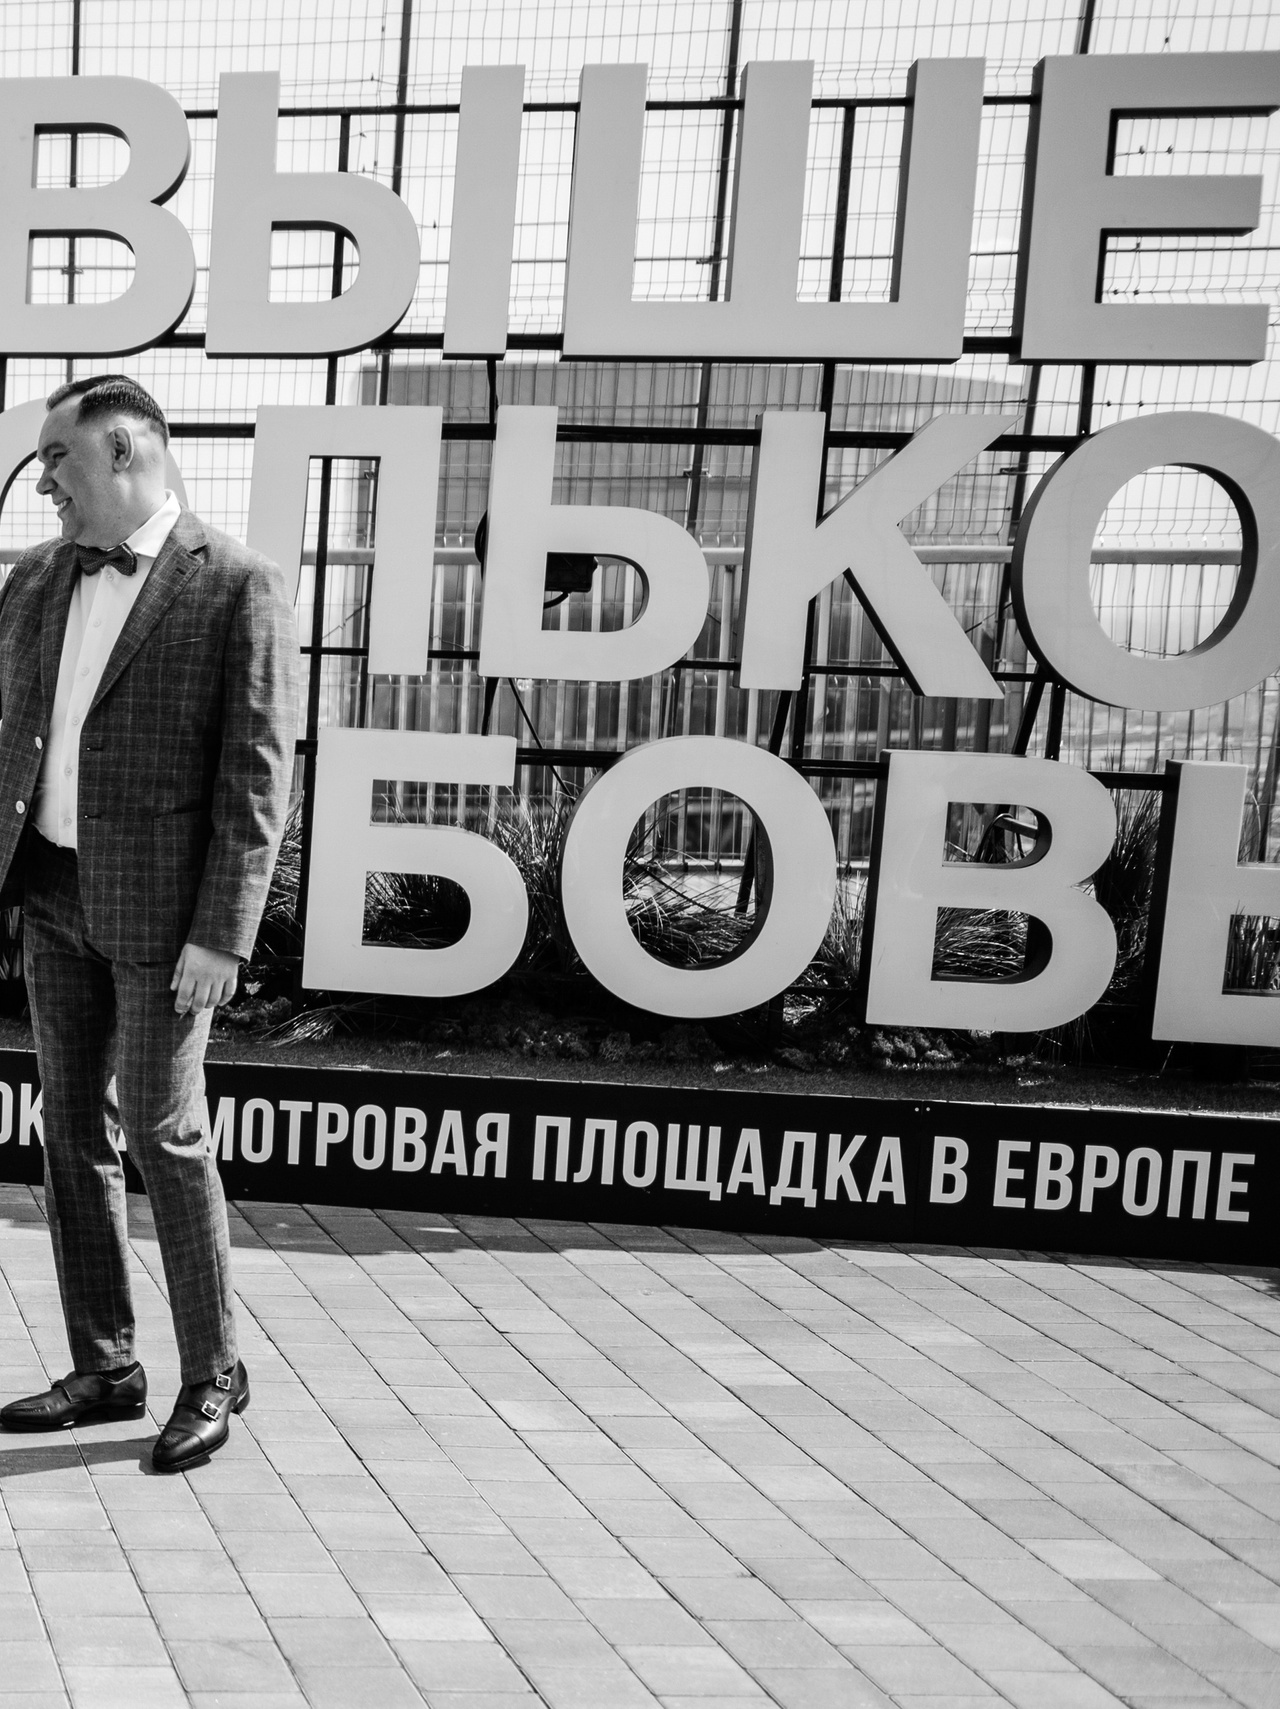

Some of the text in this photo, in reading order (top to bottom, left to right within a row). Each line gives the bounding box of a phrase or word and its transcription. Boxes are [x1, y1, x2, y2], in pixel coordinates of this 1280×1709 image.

[202, 1095, 510, 1179] МОТРОВАЯ
[531, 1115, 906, 1208] ПЛОЩАДКА
[929, 1136, 968, 1204] В
[992, 1140, 1256, 1223] ЕВРОПЕ
